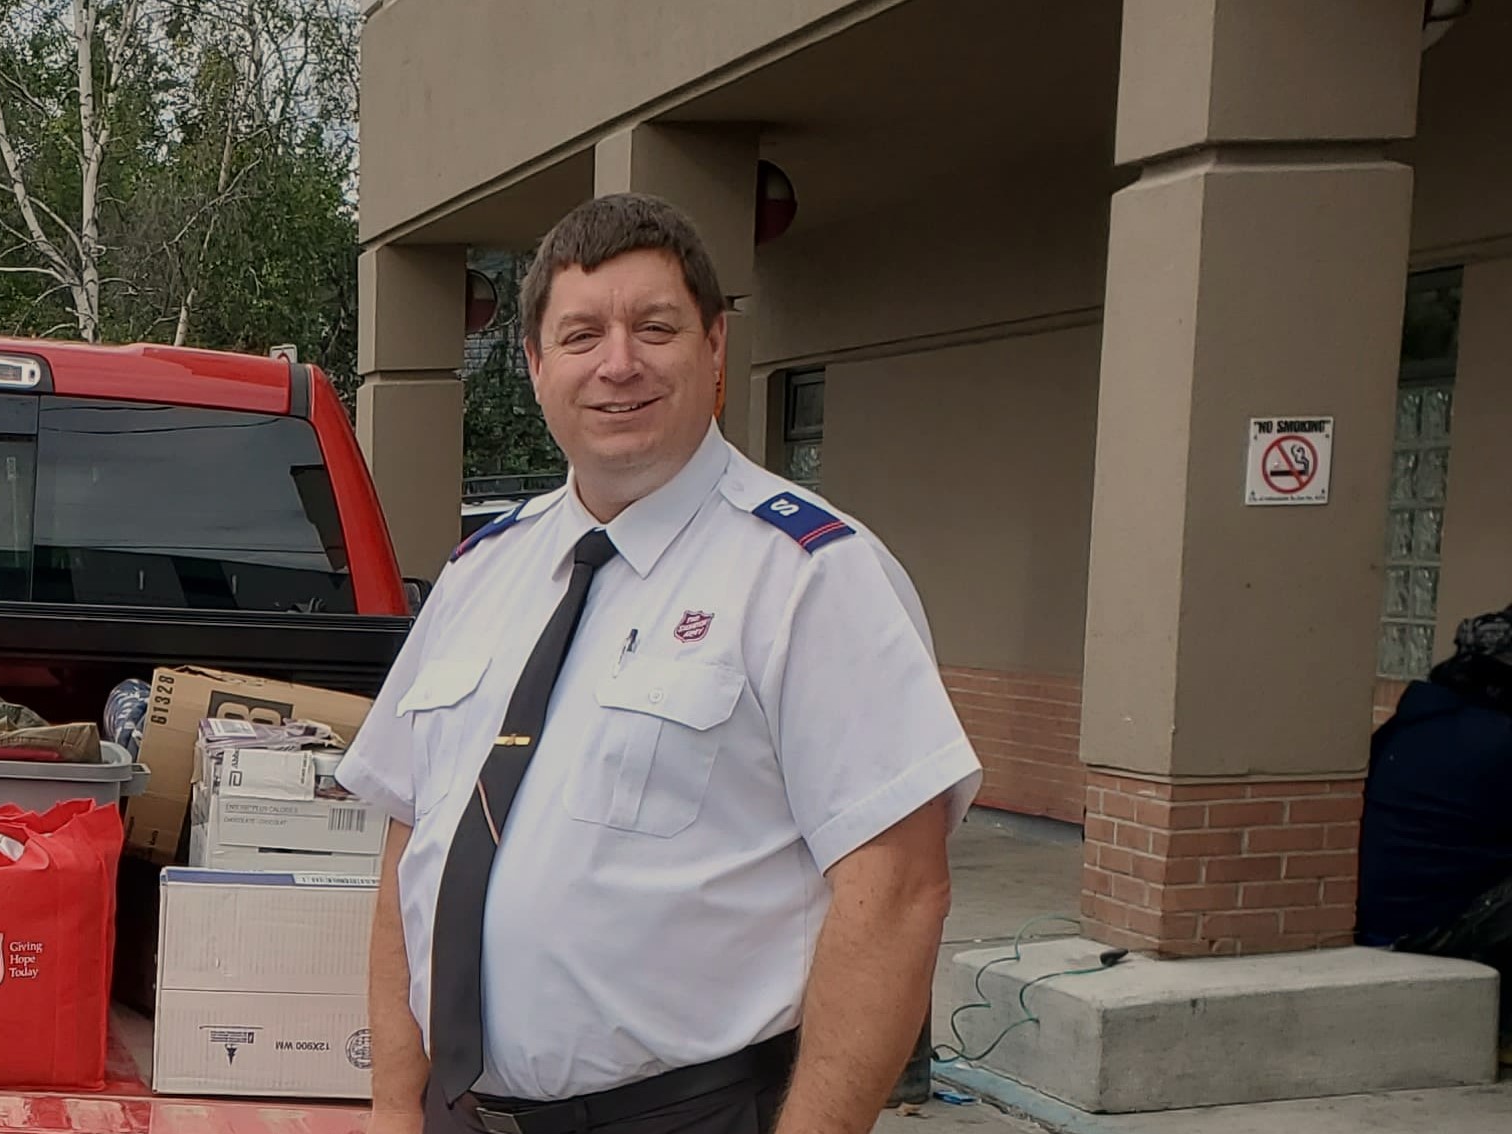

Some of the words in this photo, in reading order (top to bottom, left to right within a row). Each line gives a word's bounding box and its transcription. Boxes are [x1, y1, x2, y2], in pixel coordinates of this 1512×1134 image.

[9, 942, 43, 953] Giving
[9, 954, 36, 966] Hope
[8, 967, 39, 979] Today
[275, 1041, 294, 1050] WM
[296, 1041, 331, 1051] 12X900
